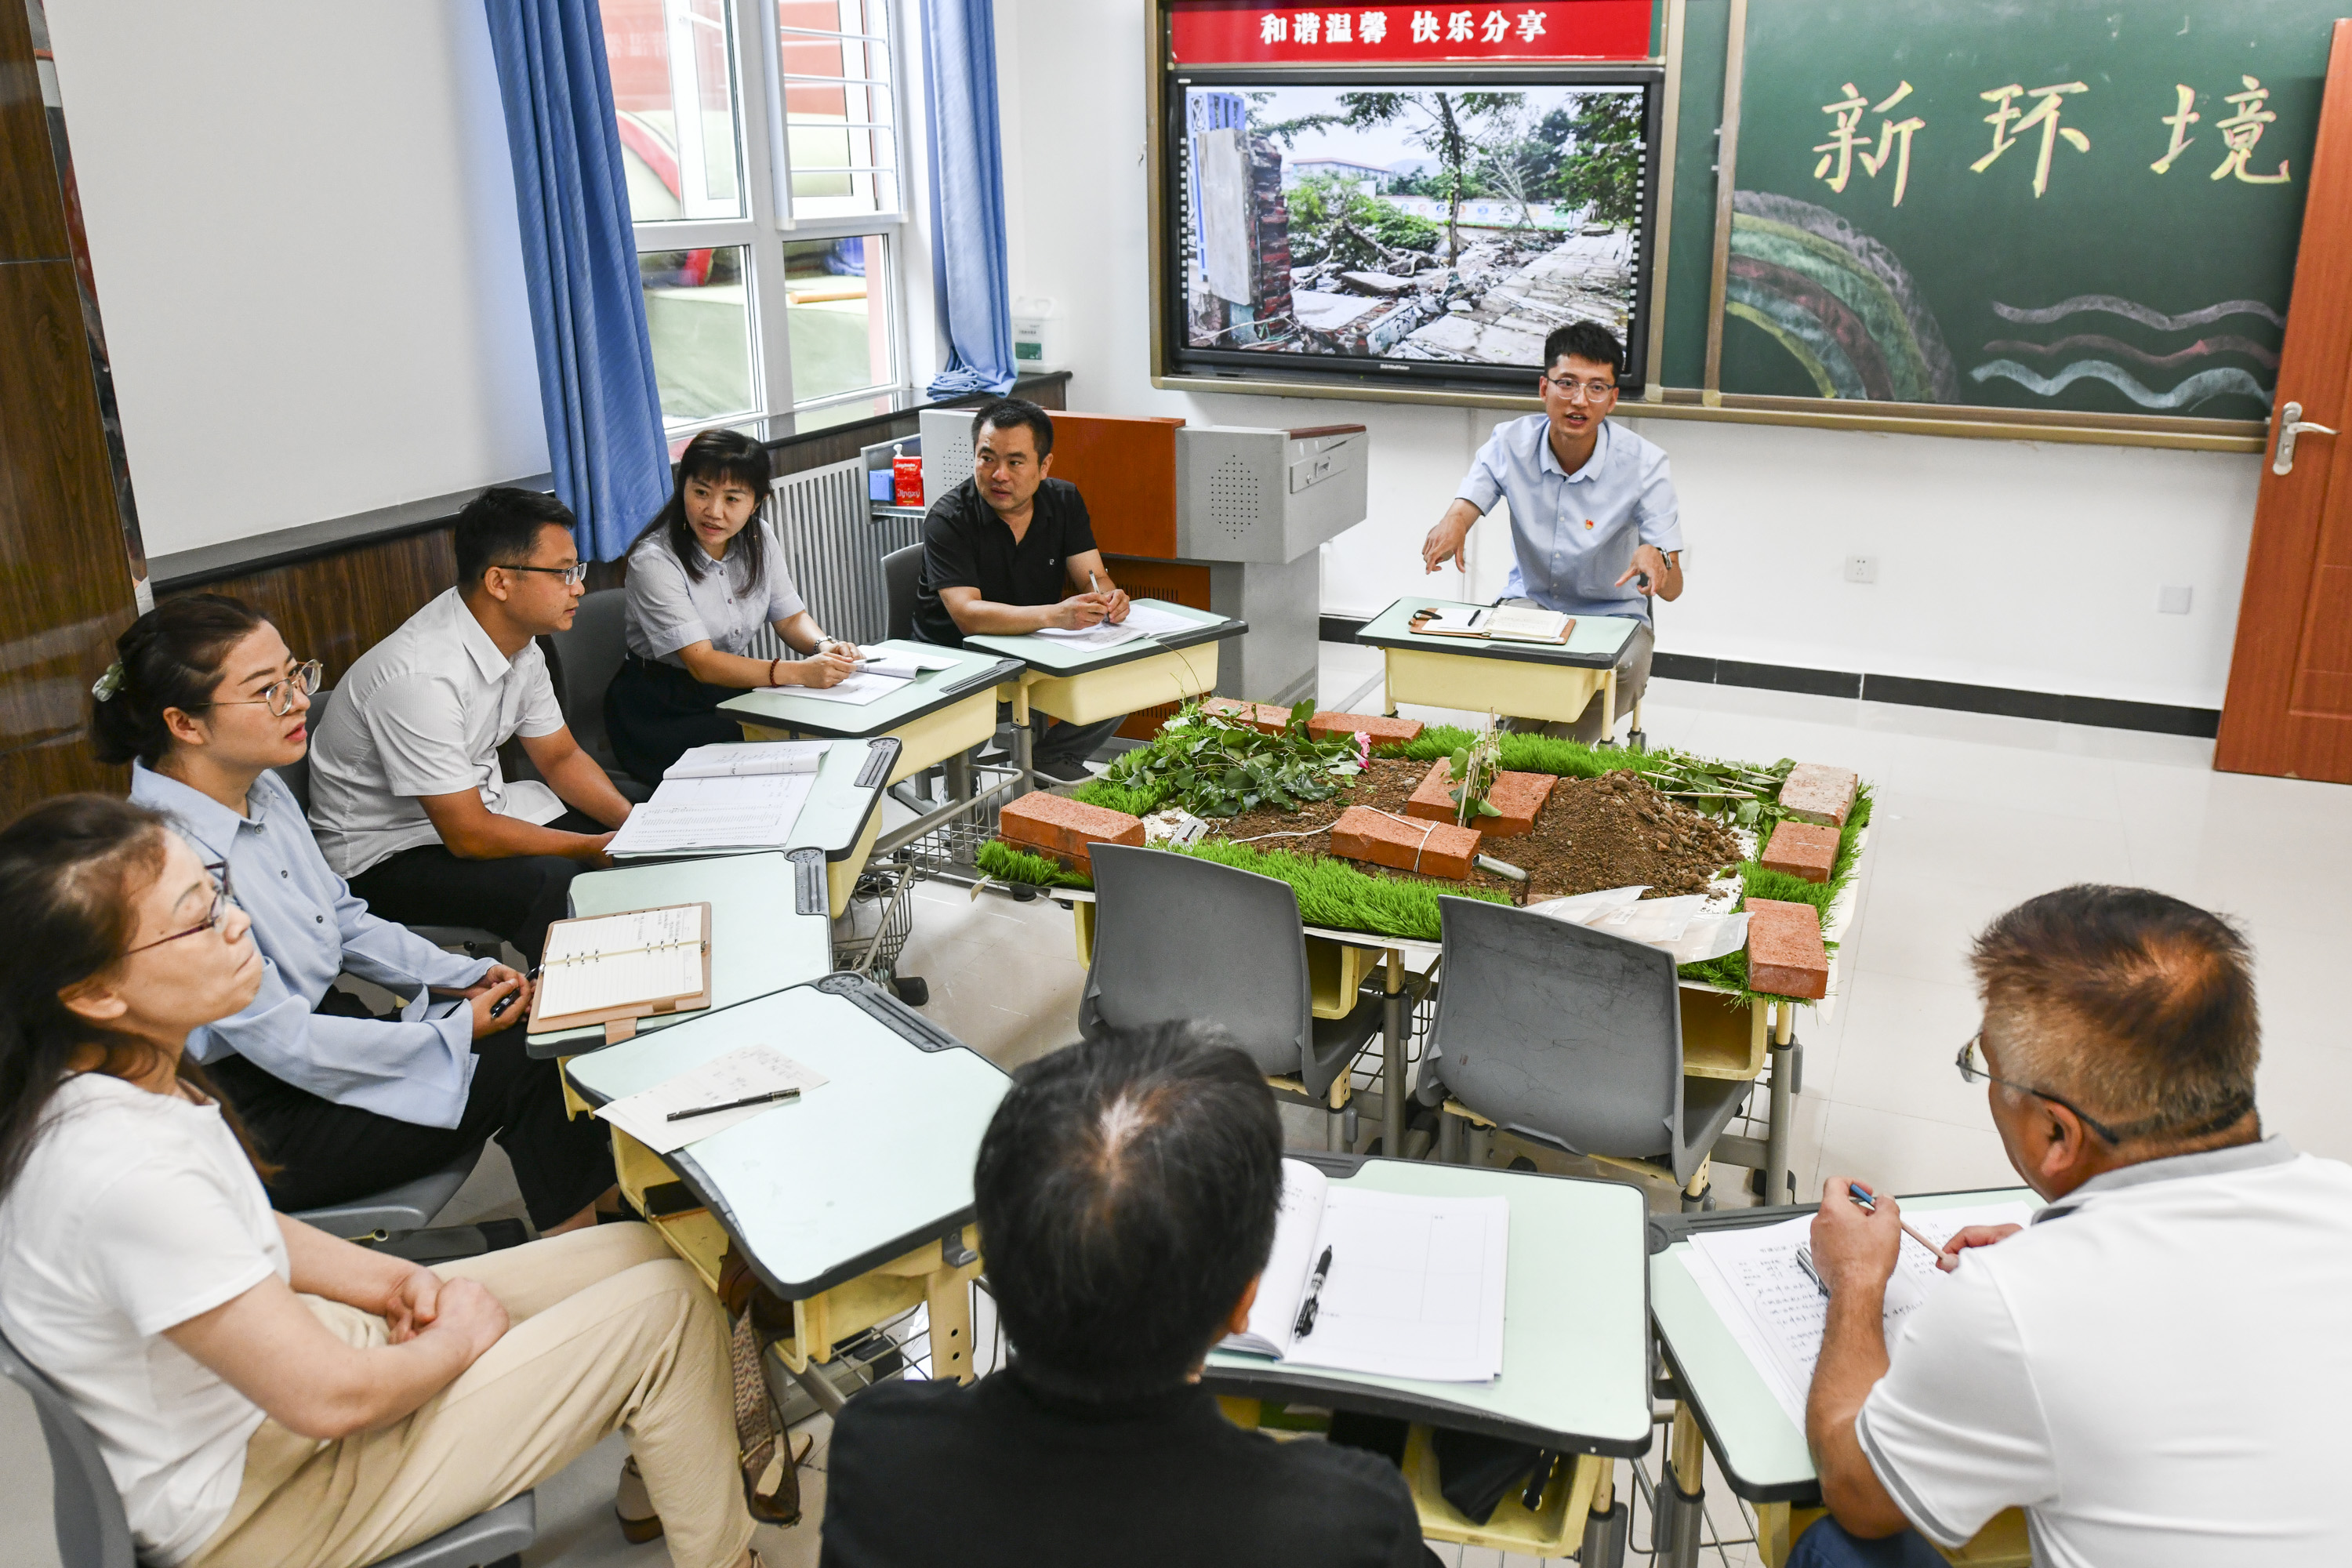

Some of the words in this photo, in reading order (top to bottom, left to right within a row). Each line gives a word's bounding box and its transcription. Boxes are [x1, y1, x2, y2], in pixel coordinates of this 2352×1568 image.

[1260, 11, 1388, 45] 和谐温馨
[1410, 9, 1547, 43] 快乐分享
